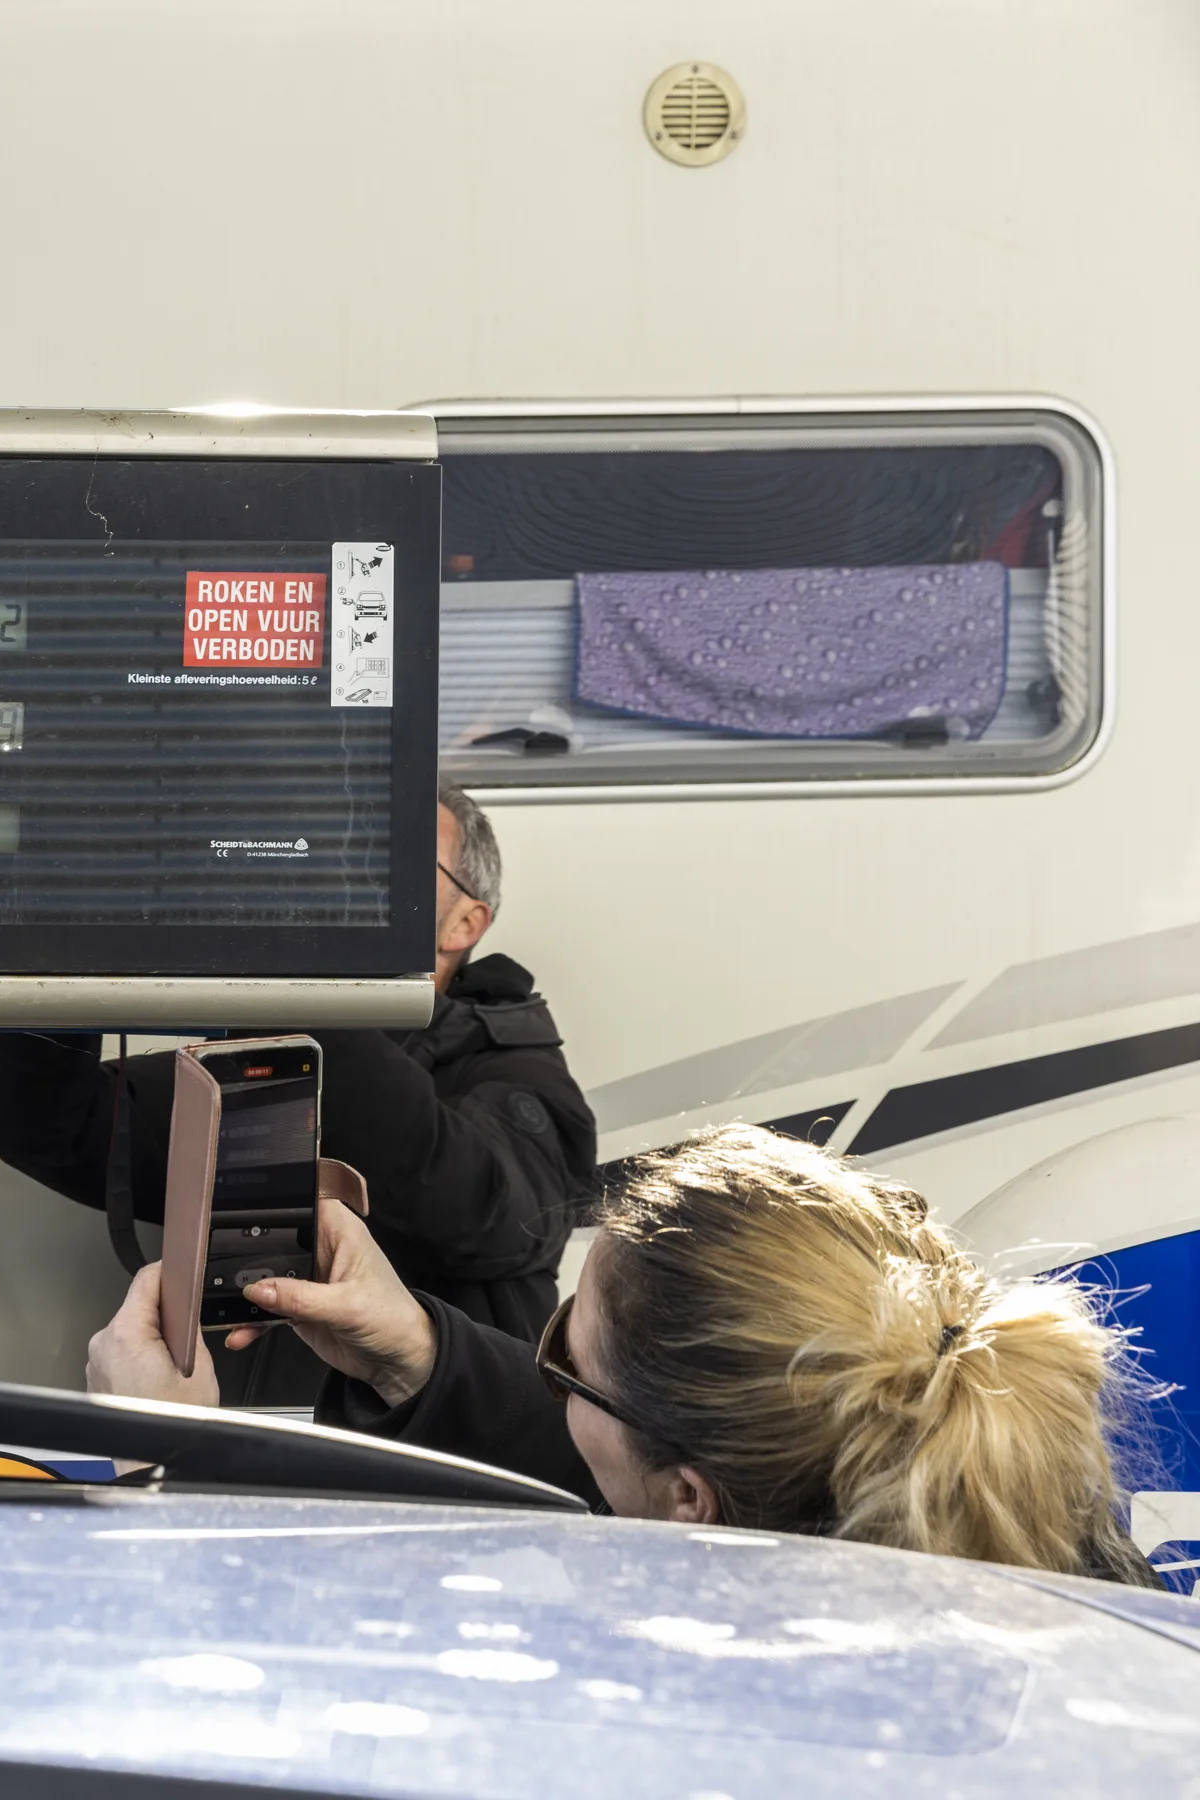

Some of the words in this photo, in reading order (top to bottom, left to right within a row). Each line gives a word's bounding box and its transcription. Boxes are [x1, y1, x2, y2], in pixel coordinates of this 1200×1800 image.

[198, 580, 274, 603] ROKEN
[284, 581, 313, 603] EN
[188, 608, 248, 632] OPEN
[257, 610, 320, 633] VUUR
[193, 638, 314, 661] VERBODEN
[128, 673, 171, 684] Kleinste
